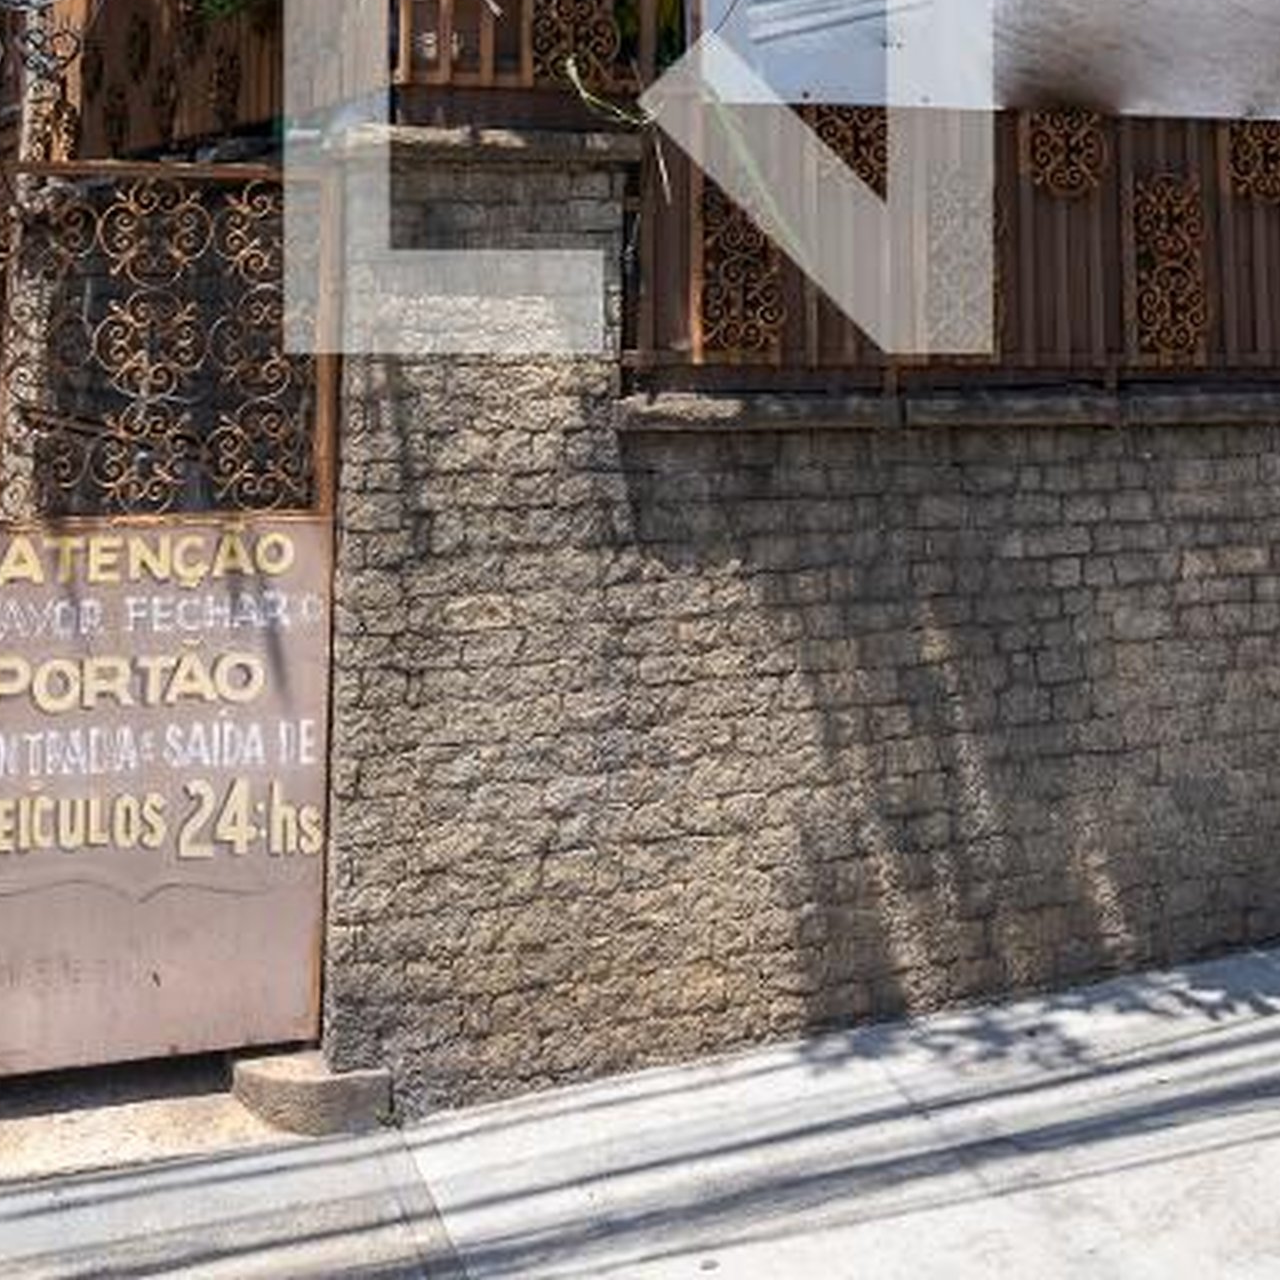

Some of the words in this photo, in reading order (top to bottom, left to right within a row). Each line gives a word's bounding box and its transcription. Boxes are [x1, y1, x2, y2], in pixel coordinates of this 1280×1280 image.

[126, 588, 292, 633] FECHAR
[164, 708, 268, 769] SAÍDA
[277, 719, 318, 766] DE
